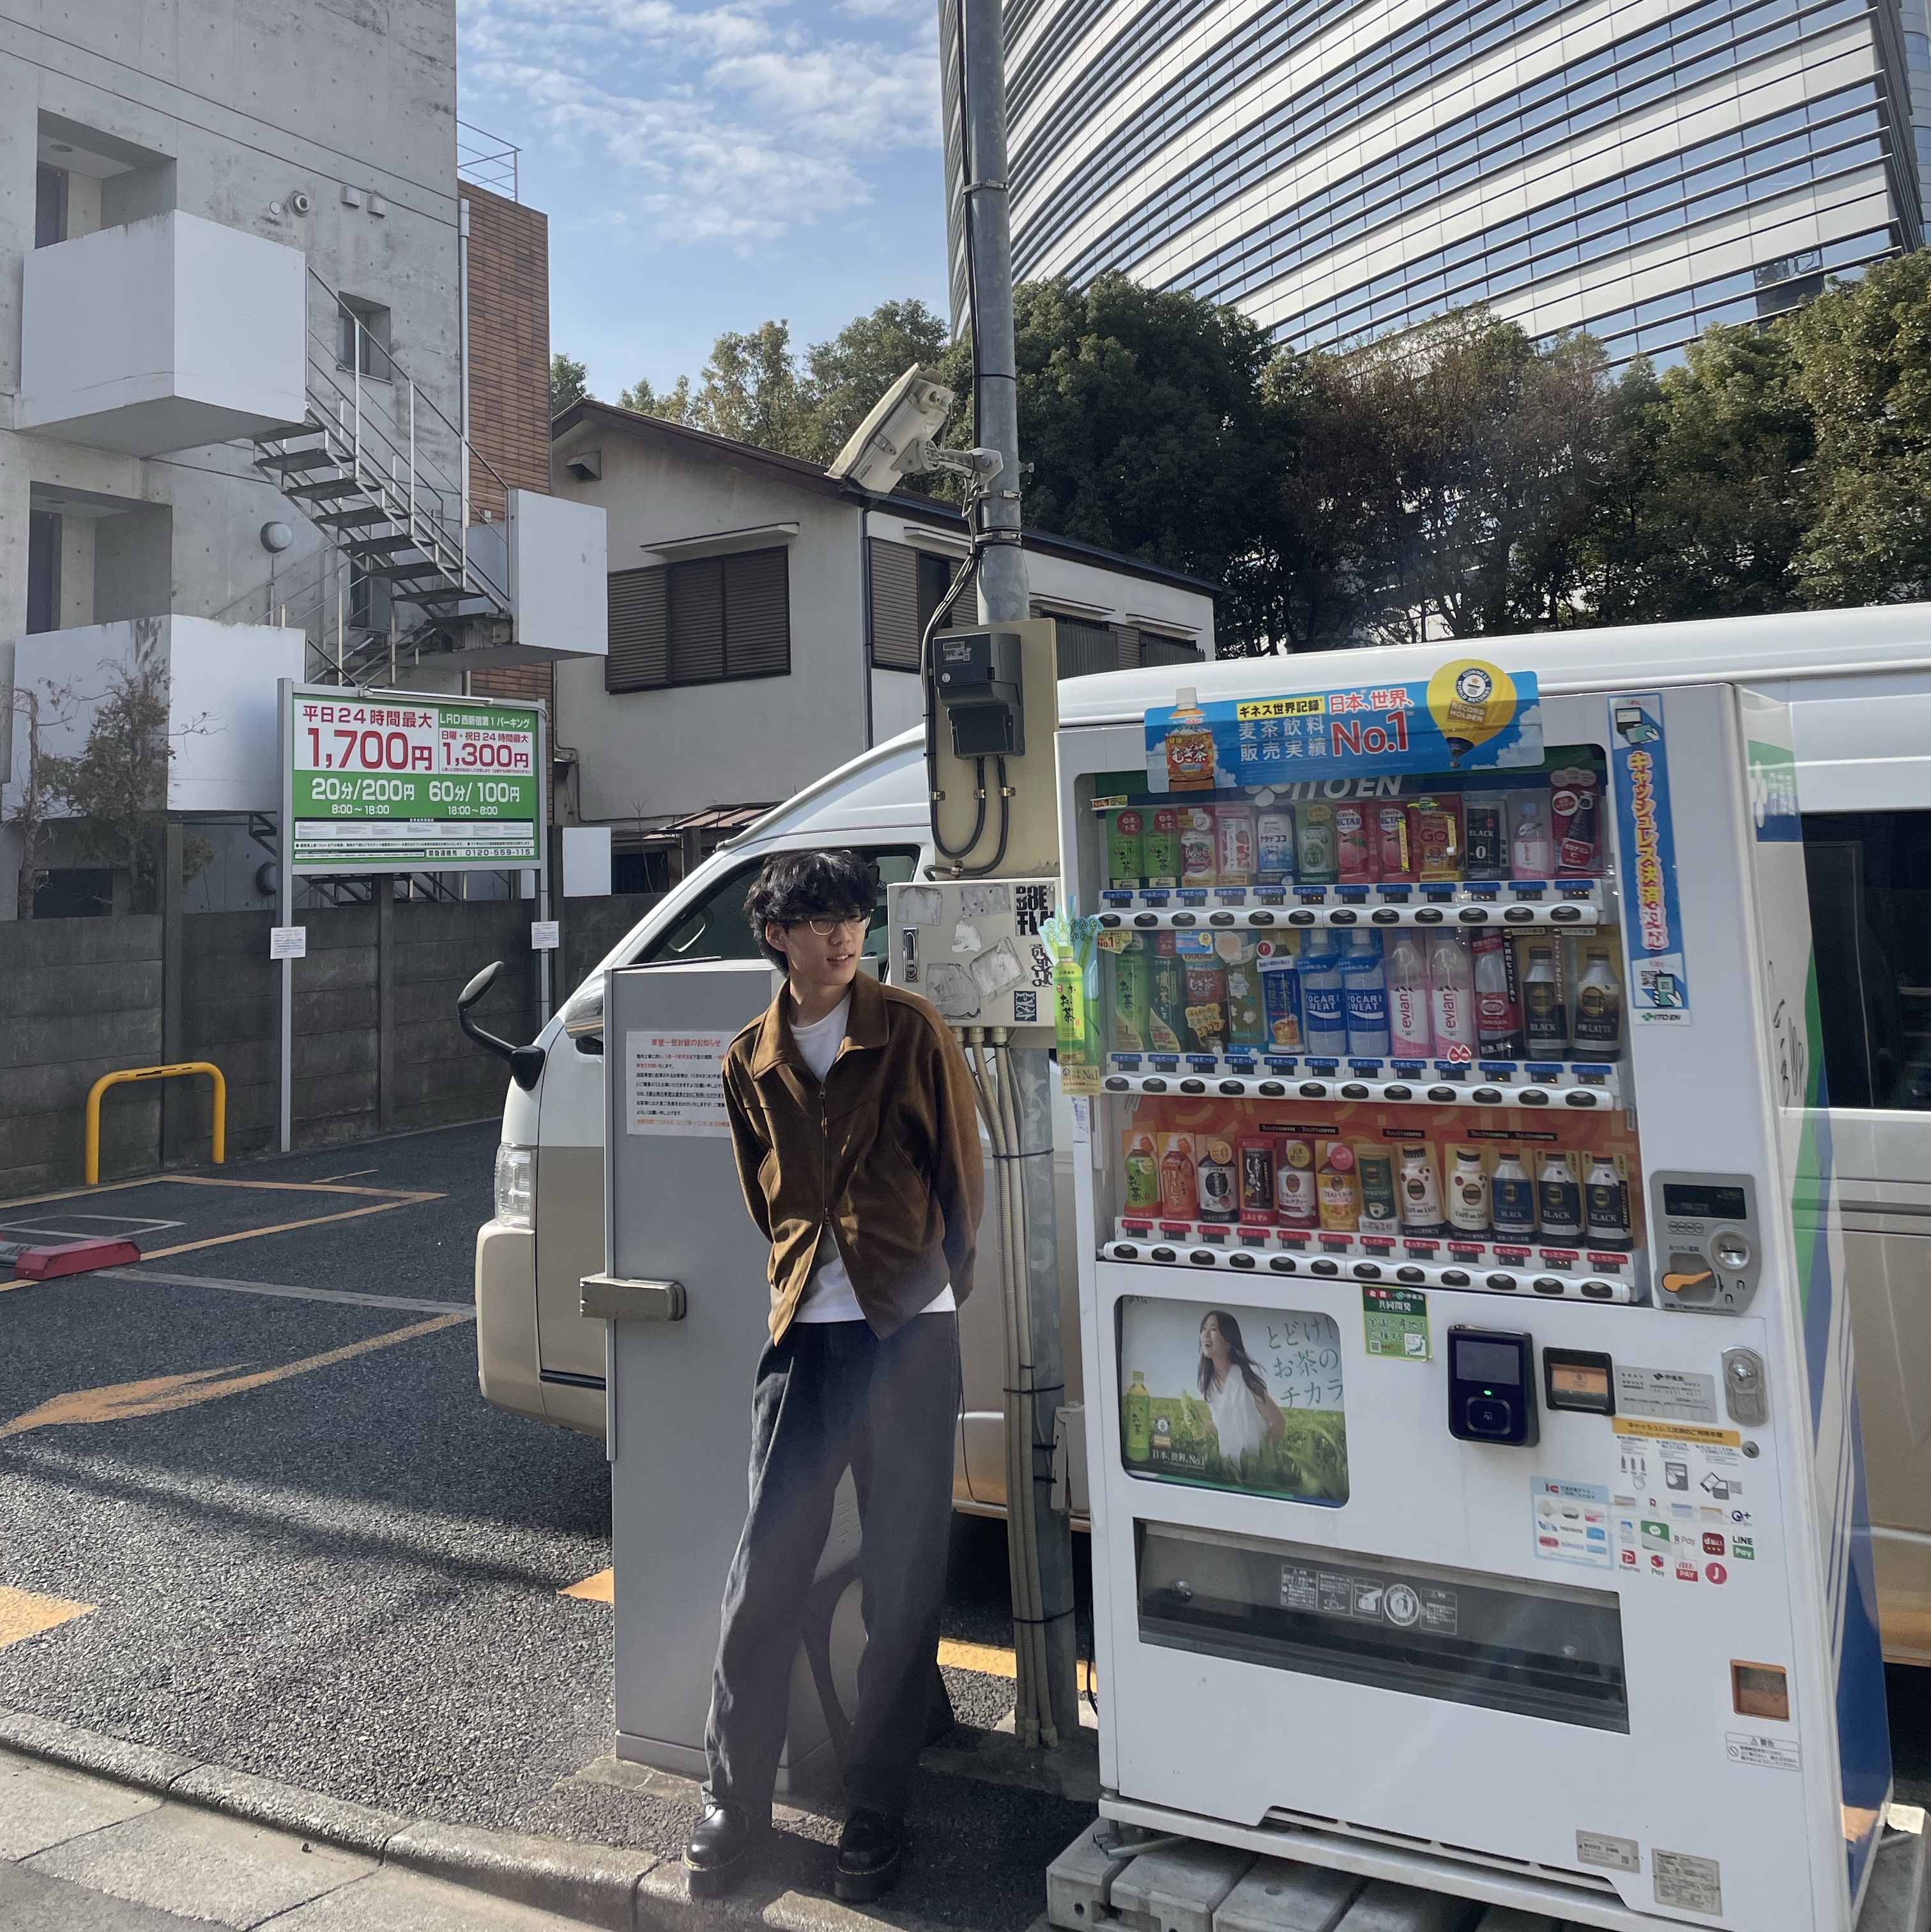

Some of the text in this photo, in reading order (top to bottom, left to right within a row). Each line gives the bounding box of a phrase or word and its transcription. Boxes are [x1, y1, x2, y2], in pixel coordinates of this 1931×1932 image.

[1462, 670, 1490, 682] GUINNESS
[1457, 680, 1491, 703] WORLD RECORDS
[303, 705, 432, 728] 平日24時間最大
[1450, 710, 1483, 723] HOLDER
[1451, 703, 1485, 715] RECORD
[1239, 715, 1325, 740] 麦茶飲料
[1331, 710, 1408, 757] No.1
[307, 727, 432, 771] 1,700円
[443, 742, 528, 768] 1,300円
[1172, 743, 1208, 763] むぎ茶
[1240, 737, 1327, 762] 販売実績
[312, 778, 415, 801] 20分/200円
[1355, 775, 1403, 797] EN
[1260, 834, 1287, 843] ナタデココ
[1399, 993, 1412, 1029] evian
[1442, 992, 1456, 1029] evian
[1543, 1210, 1571, 1220] BLACK
[1591, 1213, 1617, 1222] BLACK
[1273, 1349, 1339, 1379] お茶の
[1279, 1378, 1343, 1409] チカラ
[1681, 1535, 1695, 1546] Pay
[1732, 1535, 1753, 1545] LINE
[1736, 1547, 1752, 1557] Pay
[1619, 1564, 1641, 1574] PayPay
[1651, 1567, 1665, 1577] Pay
[1679, 1570, 1695, 1578] PAY
